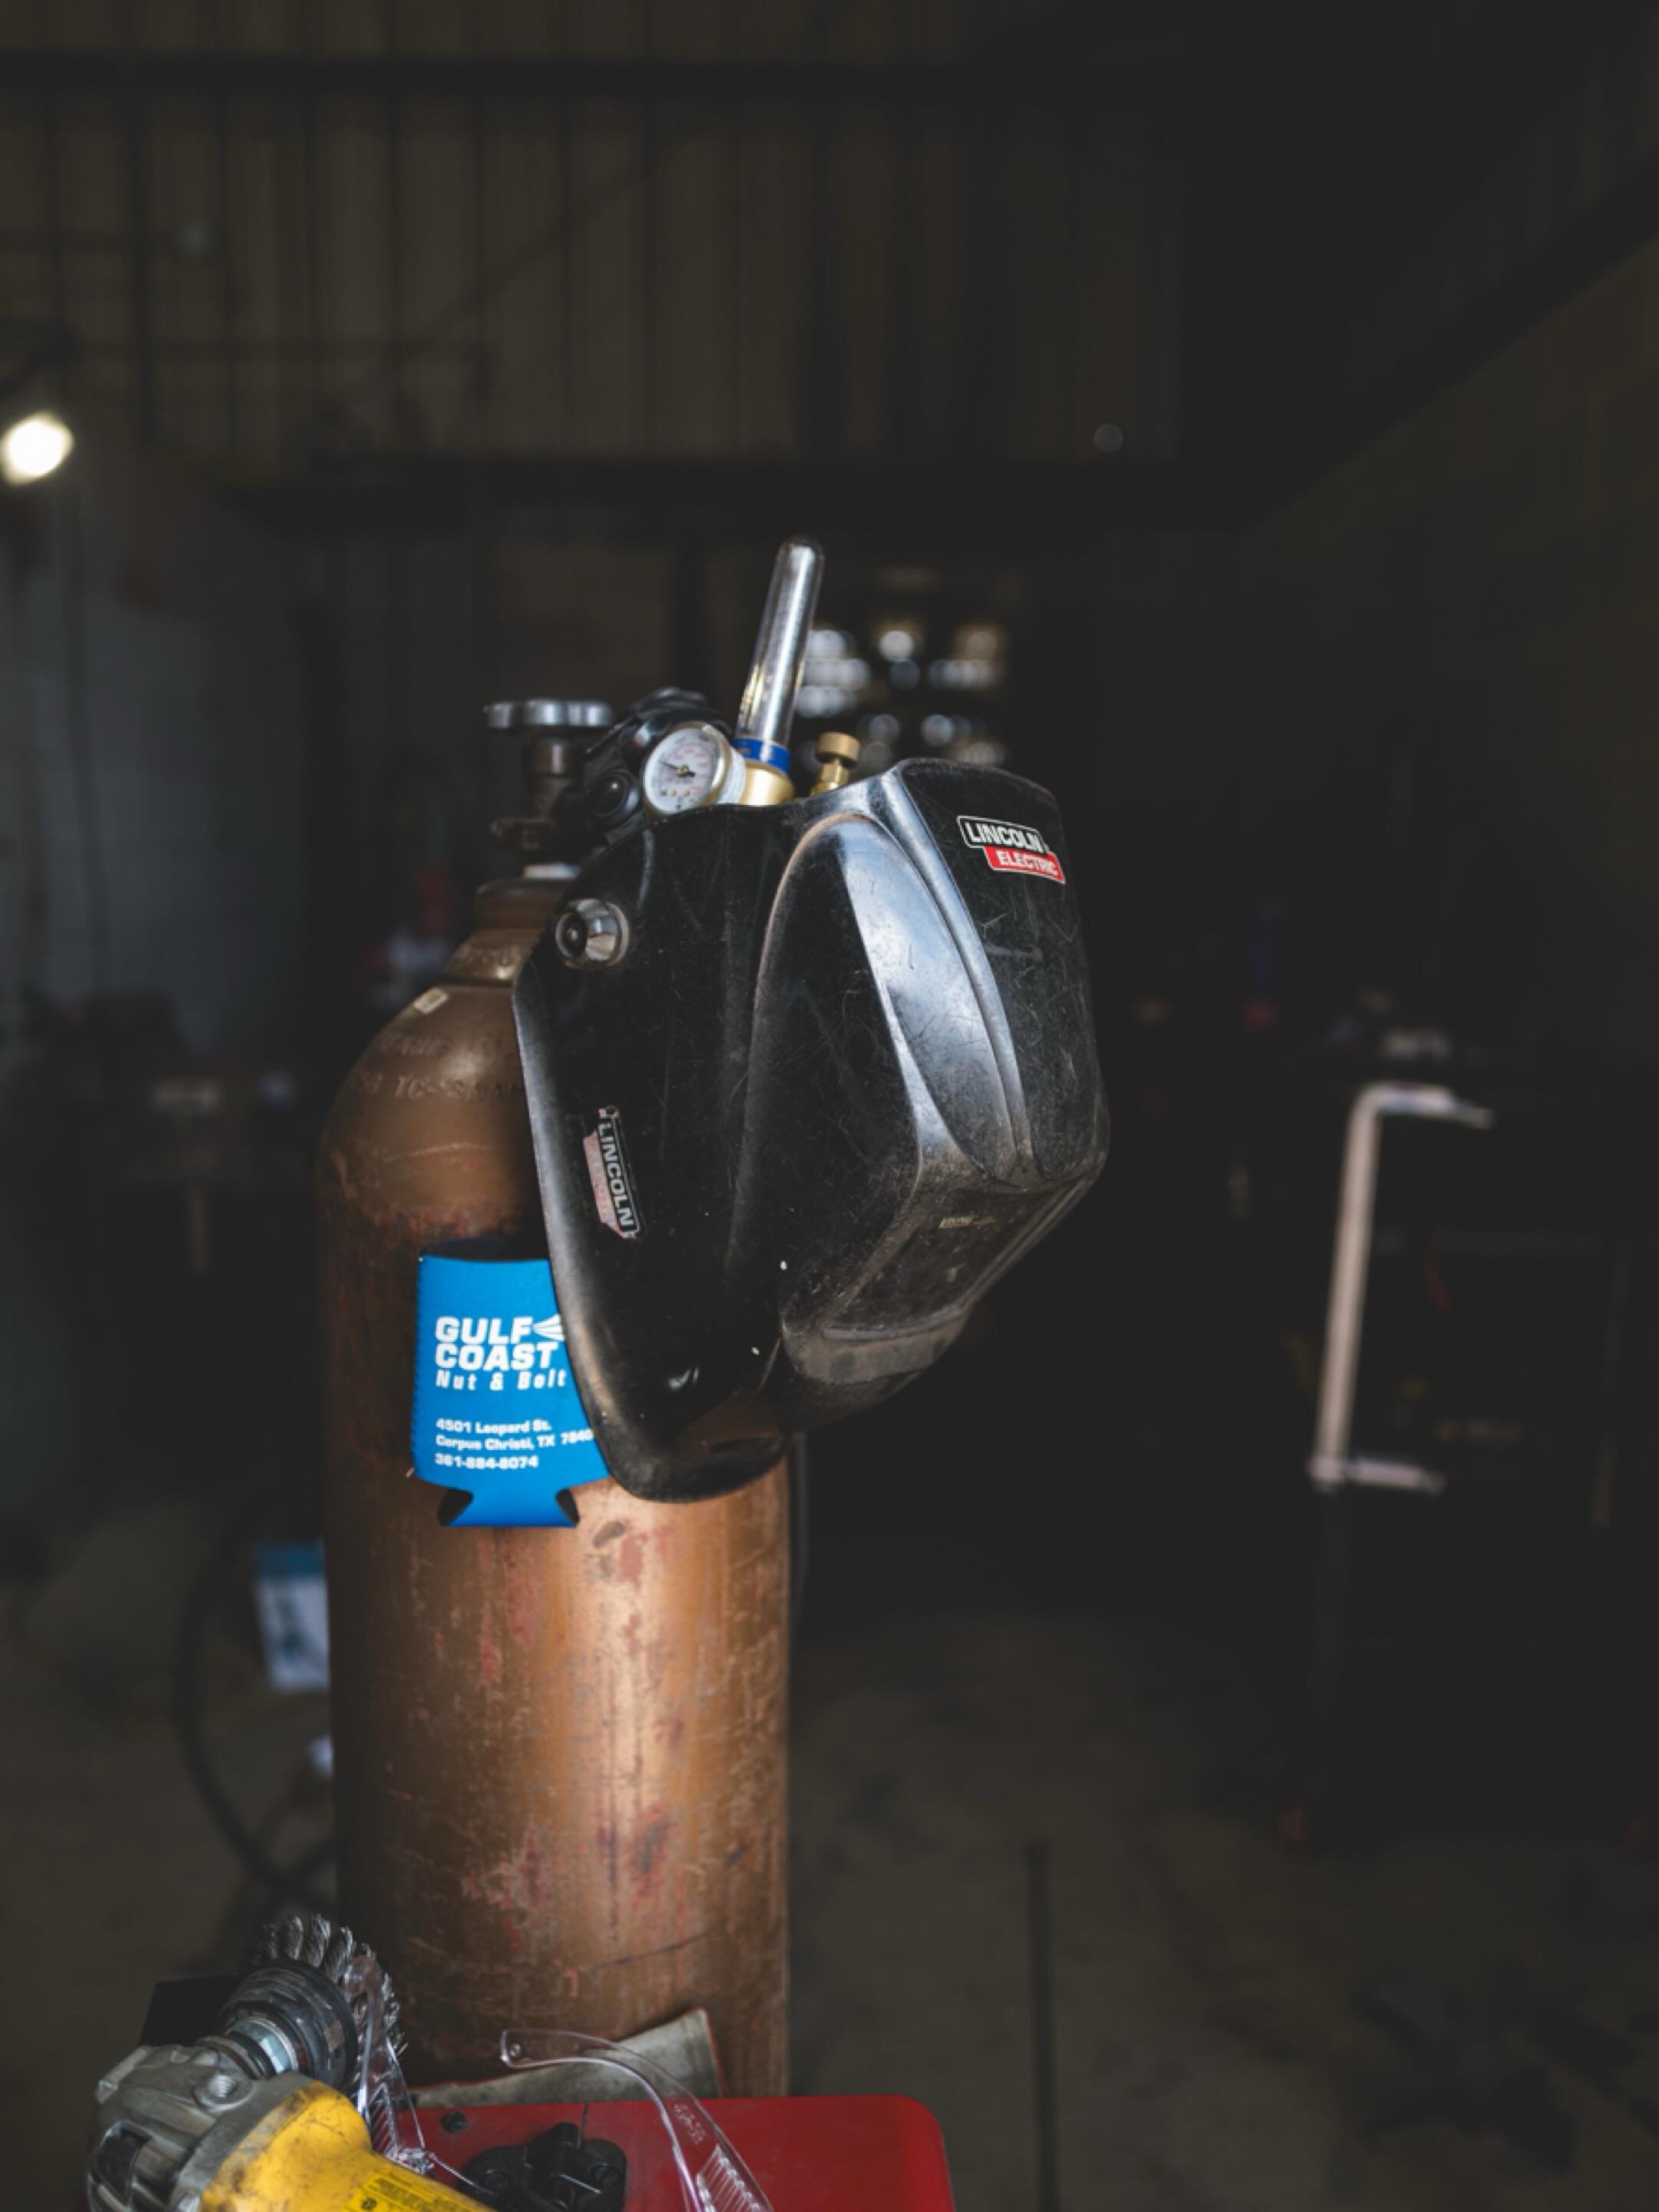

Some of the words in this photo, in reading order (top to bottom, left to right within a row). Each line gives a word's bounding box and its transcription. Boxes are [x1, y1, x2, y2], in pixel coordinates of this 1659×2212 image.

[965, 821, 1045, 854] LINCOLN
[995, 850, 1058, 876] ELECTRIC
[598, 1123, 634, 1226] LINCOLN
[435, 1316, 532, 1343] GULF
[435, 1343, 558, 1371] COAST
[435, 1370, 476, 1390] Nut
[490, 1370, 504, 1390] &
[517, 1368, 566, 1390] Bolt
[475, 1420, 529, 1437] Leopard
[435, 1435, 482, 1452] Corpus
[484, 1438, 535, 1450] Christi,
[537, 1434, 555, 1448] TX
